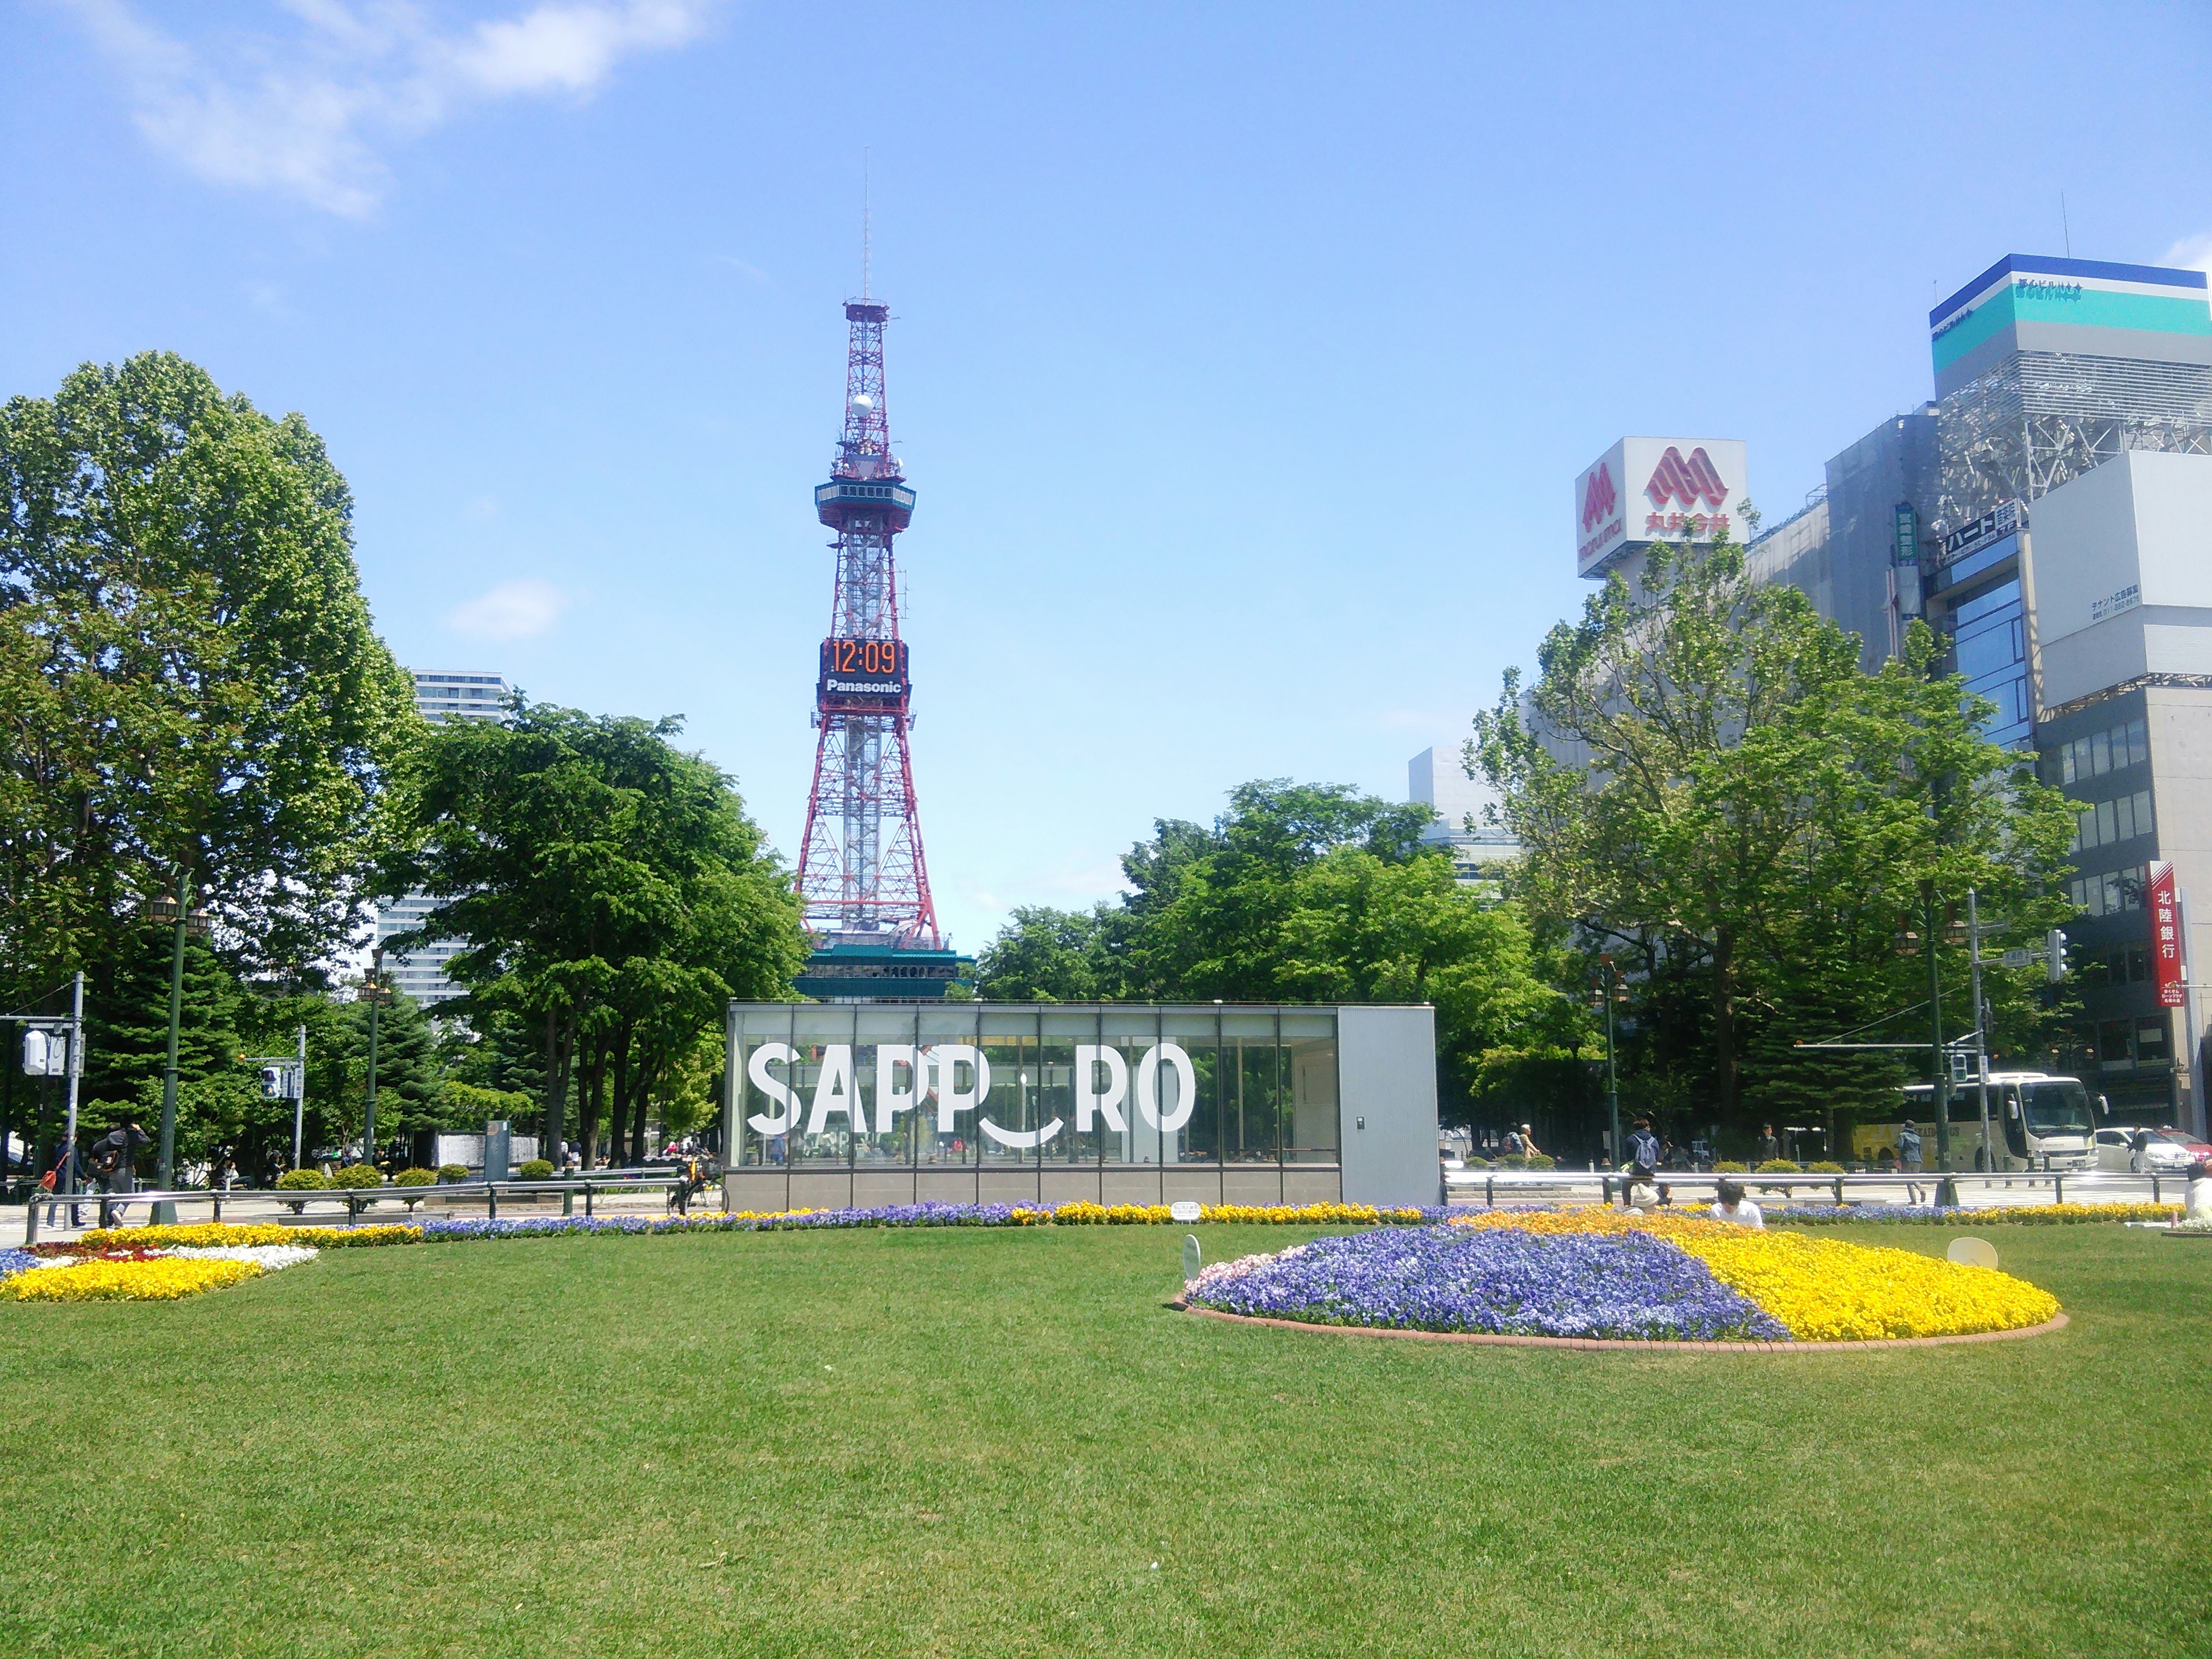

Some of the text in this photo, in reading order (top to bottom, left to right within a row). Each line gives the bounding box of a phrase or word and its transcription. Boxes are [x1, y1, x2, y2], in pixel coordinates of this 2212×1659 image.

[1948, 518, 1993, 551] ハート
[834, 641, 895, 673] 12:09
[827, 679, 901, 693] Panasonic
[2157, 890, 2174, 958] 北陸銀行
